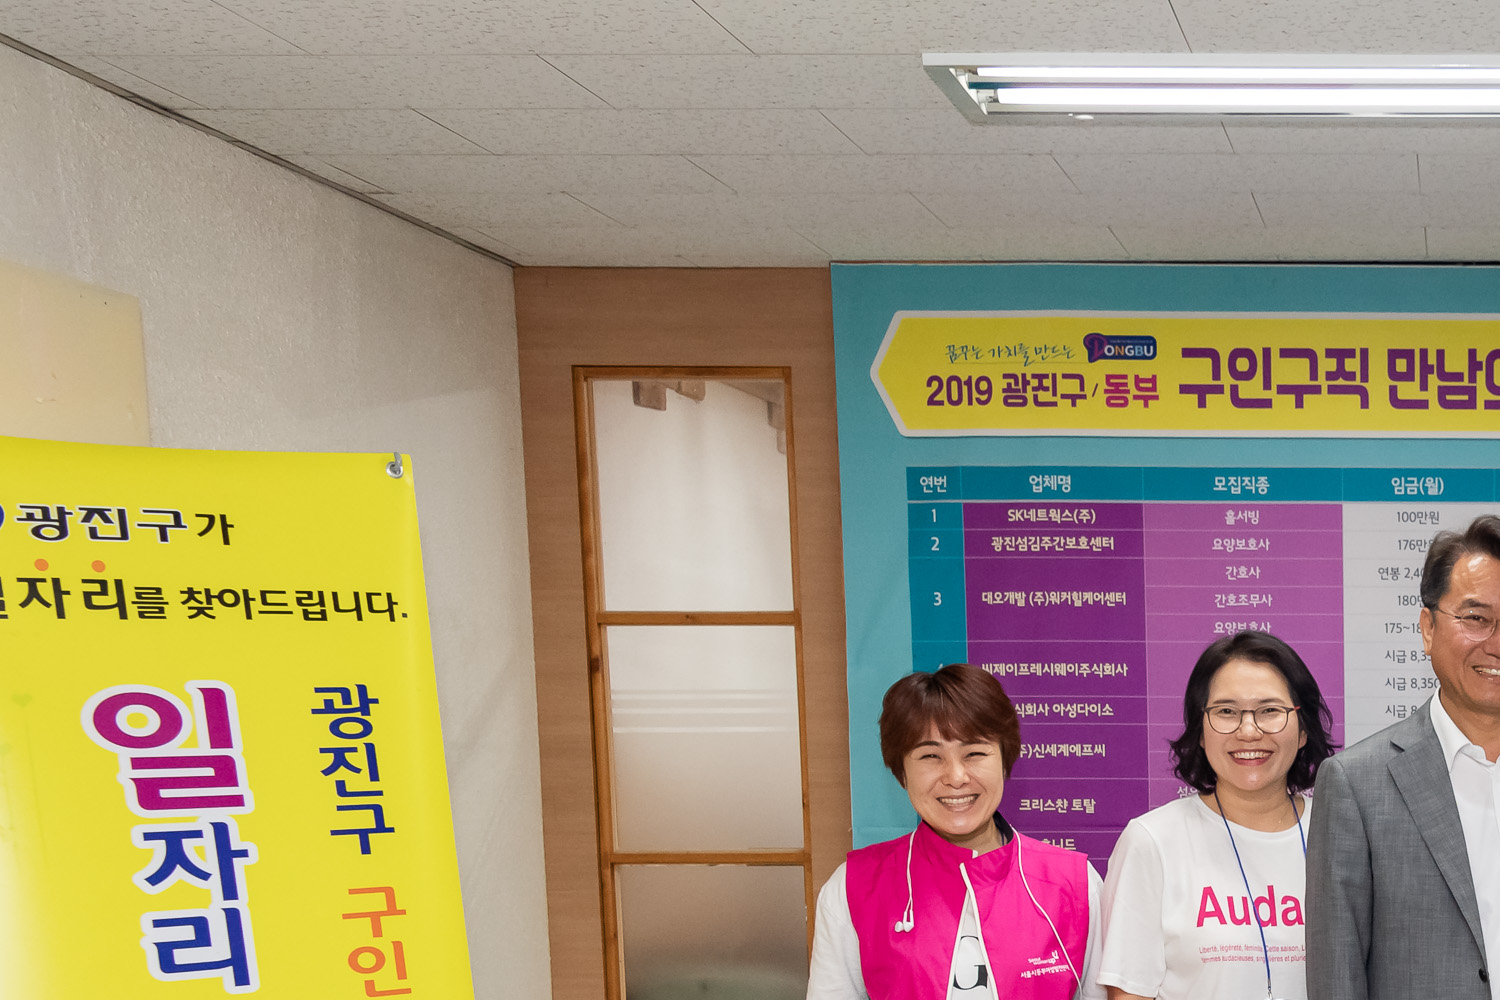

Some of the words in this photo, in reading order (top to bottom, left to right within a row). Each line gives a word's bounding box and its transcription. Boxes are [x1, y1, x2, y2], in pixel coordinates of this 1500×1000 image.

[945, 345, 984, 364] 꿈꾸는
[1034, 344, 1077, 360] 만드는
[1085, 334, 1154, 360] DONGBU
[926, 374, 993, 406] 2019
[1179, 347, 1369, 409] 구인구직
[920, 475, 947, 493] 연번
[1029, 475, 1072, 493] 업체명
[1213, 476, 1270, 495] 모집직종
[1391, 476, 1444, 496] 임금(월)
[931, 509, 937, 523] 1
[1224, 509, 1260, 525] 홀서빙
[1397, 511, 1439, 525] 100만원
[931, 537, 940, 551] 2
[991, 536, 1115, 552] 광진섬김주간보호센터
[1212, 538, 1270, 553] 요양보호사
[1225, 566, 1261, 582] 간호사
[1378, 567, 1400, 581] 연봉
[180, 586, 409, 622] 찾아드립니다.
[933, 592, 942, 606] 3
[982, 591, 1026, 606] 대오개발
[1214, 593, 1273, 608] 간호조무사
[1385, 650, 1407, 664] 시급
[1385, 678, 1407, 692] 시급
[1014, 703, 1049, 718] 식회사
[1052, 703, 1114, 718] 아성다이소
[1385, 705, 1407, 719] 시급
[311, 683, 396, 855] 광진구
[1071, 799, 1096, 814] 토탈
[93, 687, 251, 988] 일자리
